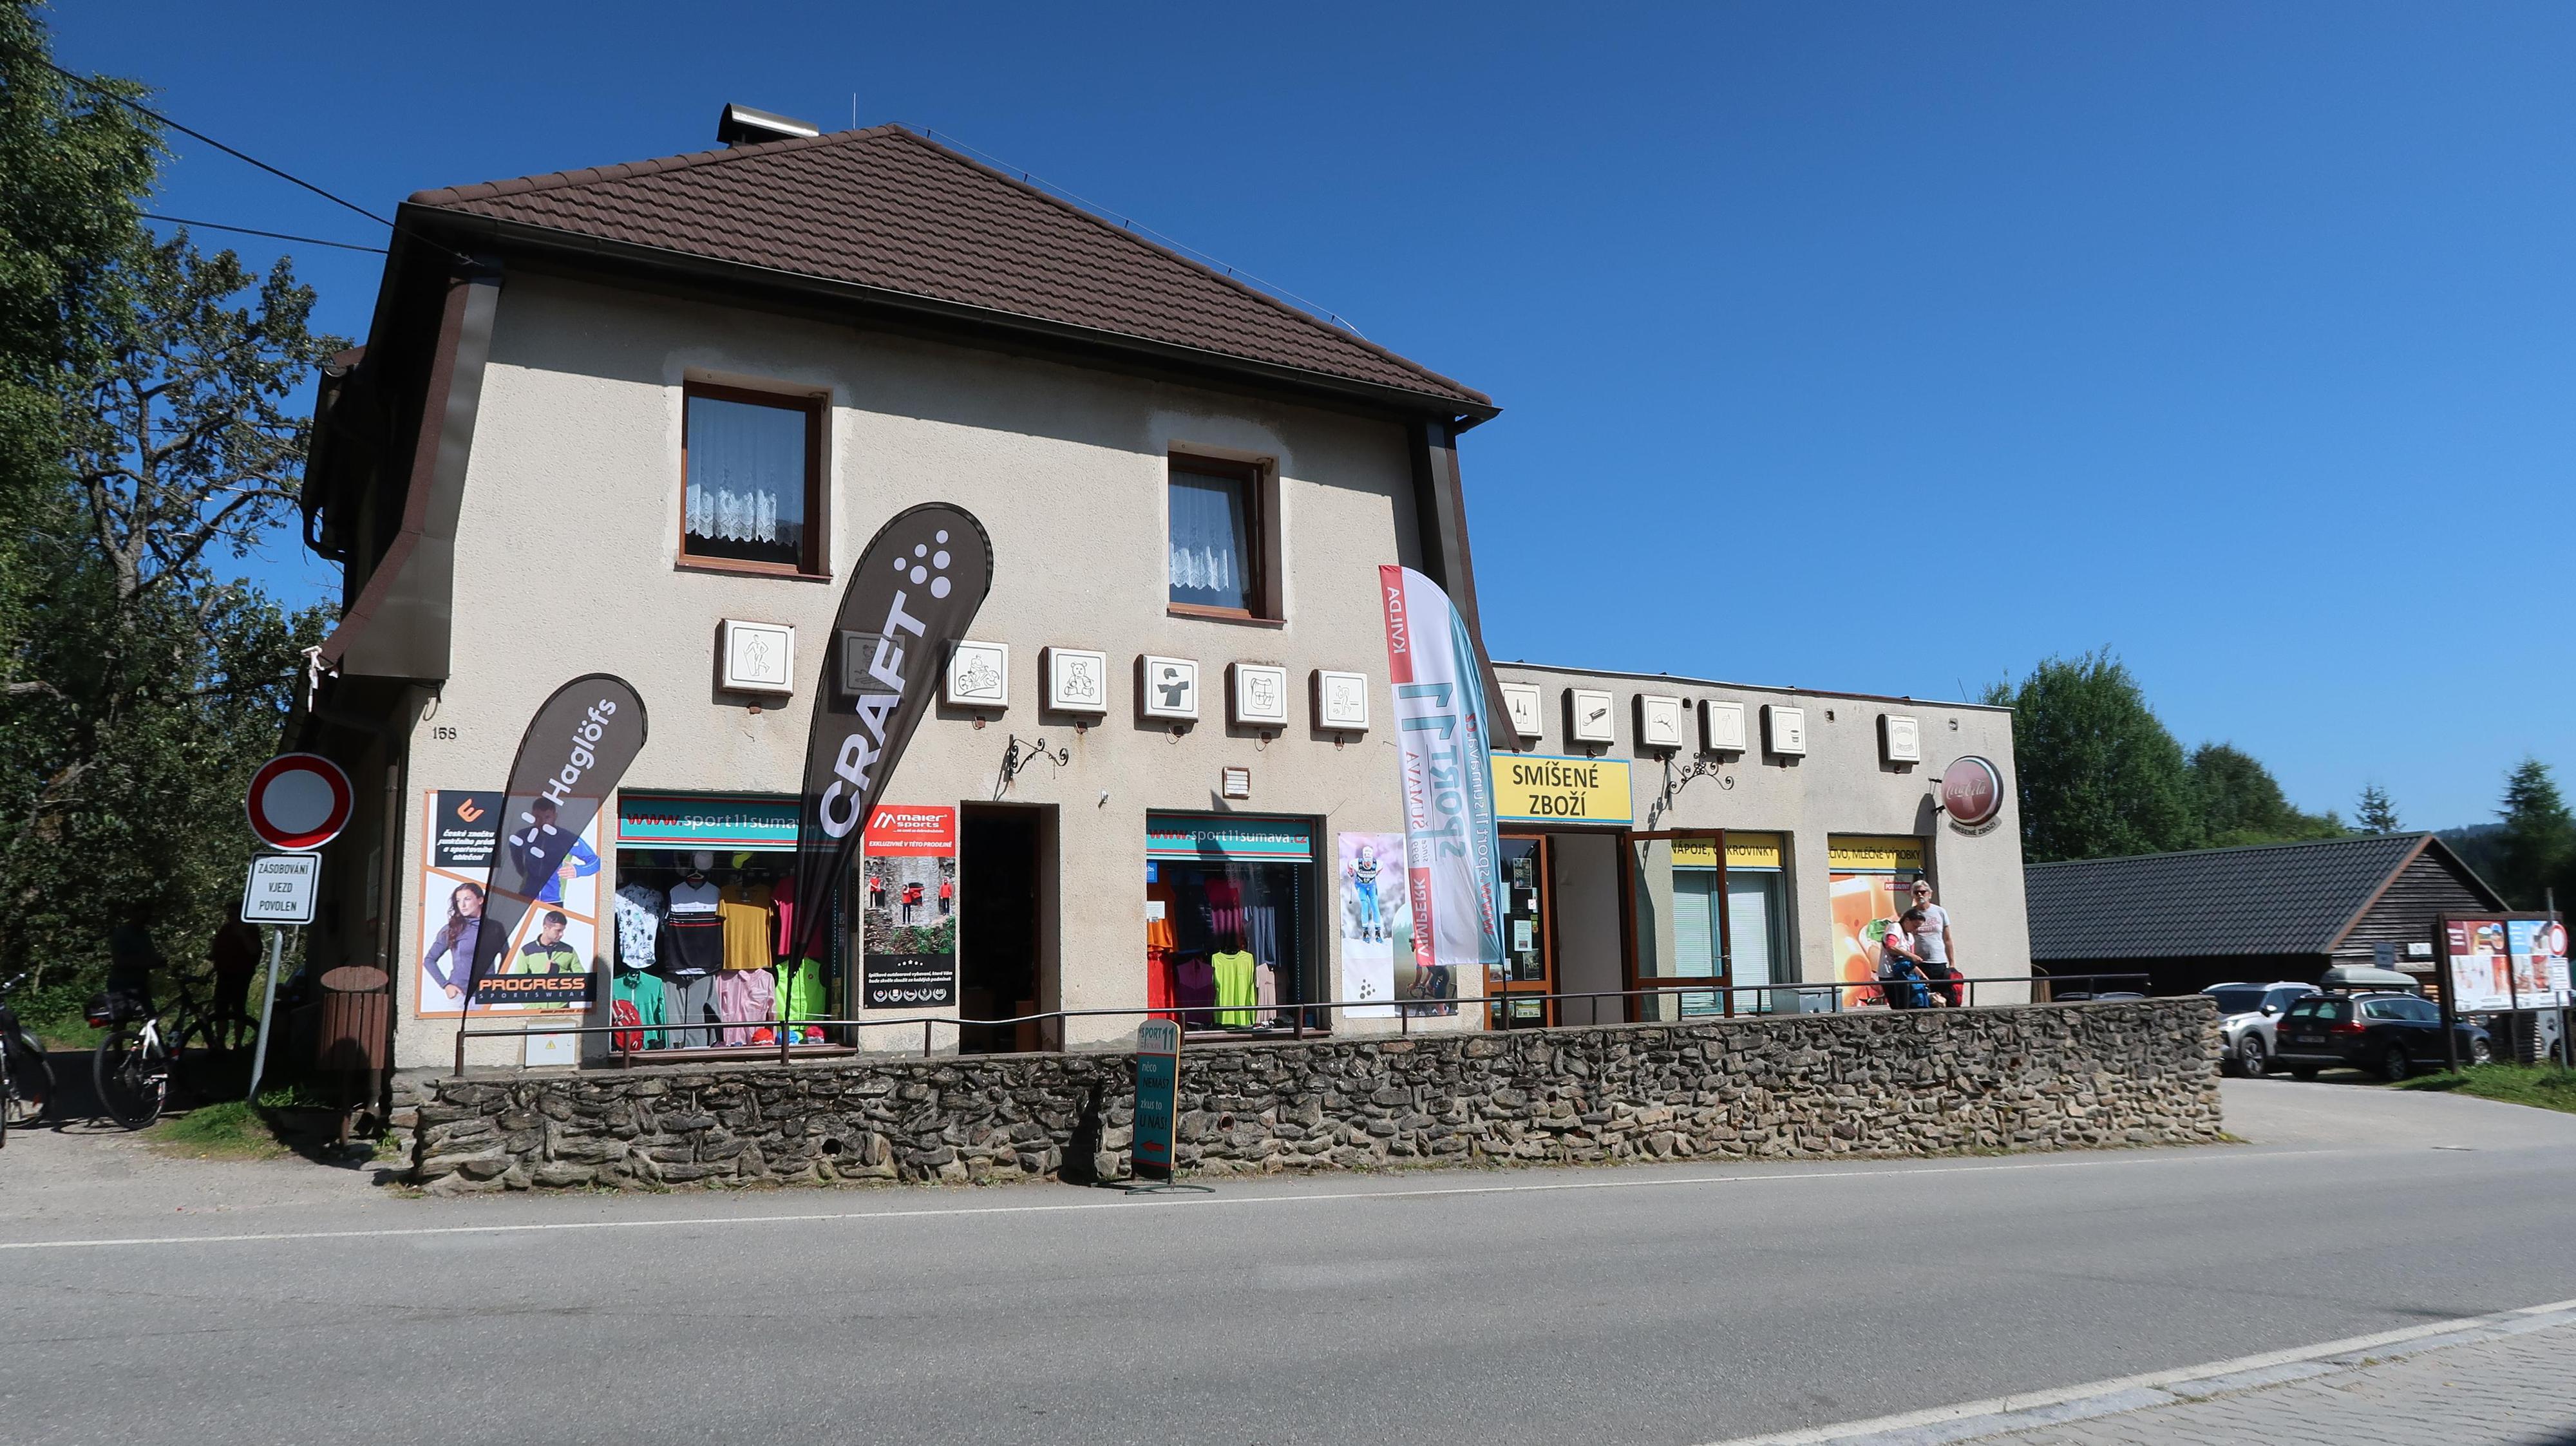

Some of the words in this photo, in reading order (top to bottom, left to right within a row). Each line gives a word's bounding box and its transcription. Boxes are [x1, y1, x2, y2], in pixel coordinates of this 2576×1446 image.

[820, 590, 926, 838] CRAFT
[433, 727, 457, 739] 158
[542, 699, 616, 806] Haglöfs
[1513, 761, 1599, 788] SMÍŠENÉ
[1528, 791, 1586, 816] ZBOŽÍ
[1148, 829, 1307, 844] www.sport11sumava.cz
[1671, 841, 1710, 857] NÁPOJE,
[1713, 845, 1774, 857] CKROVINKY
[258, 862, 308, 874] ZÁSOBOVÁNÍ
[269, 883, 293, 893] VJEZD
[259, 901, 297, 912] POVOLEN
[479, 978, 585, 991] PROGRESS
[1142, 1027, 1162, 1050] SPORT
[1162, 1027, 1175, 1051] 11
[1141, 1099, 1154, 1109] zkus
[1155, 1100, 1162, 1110] to
